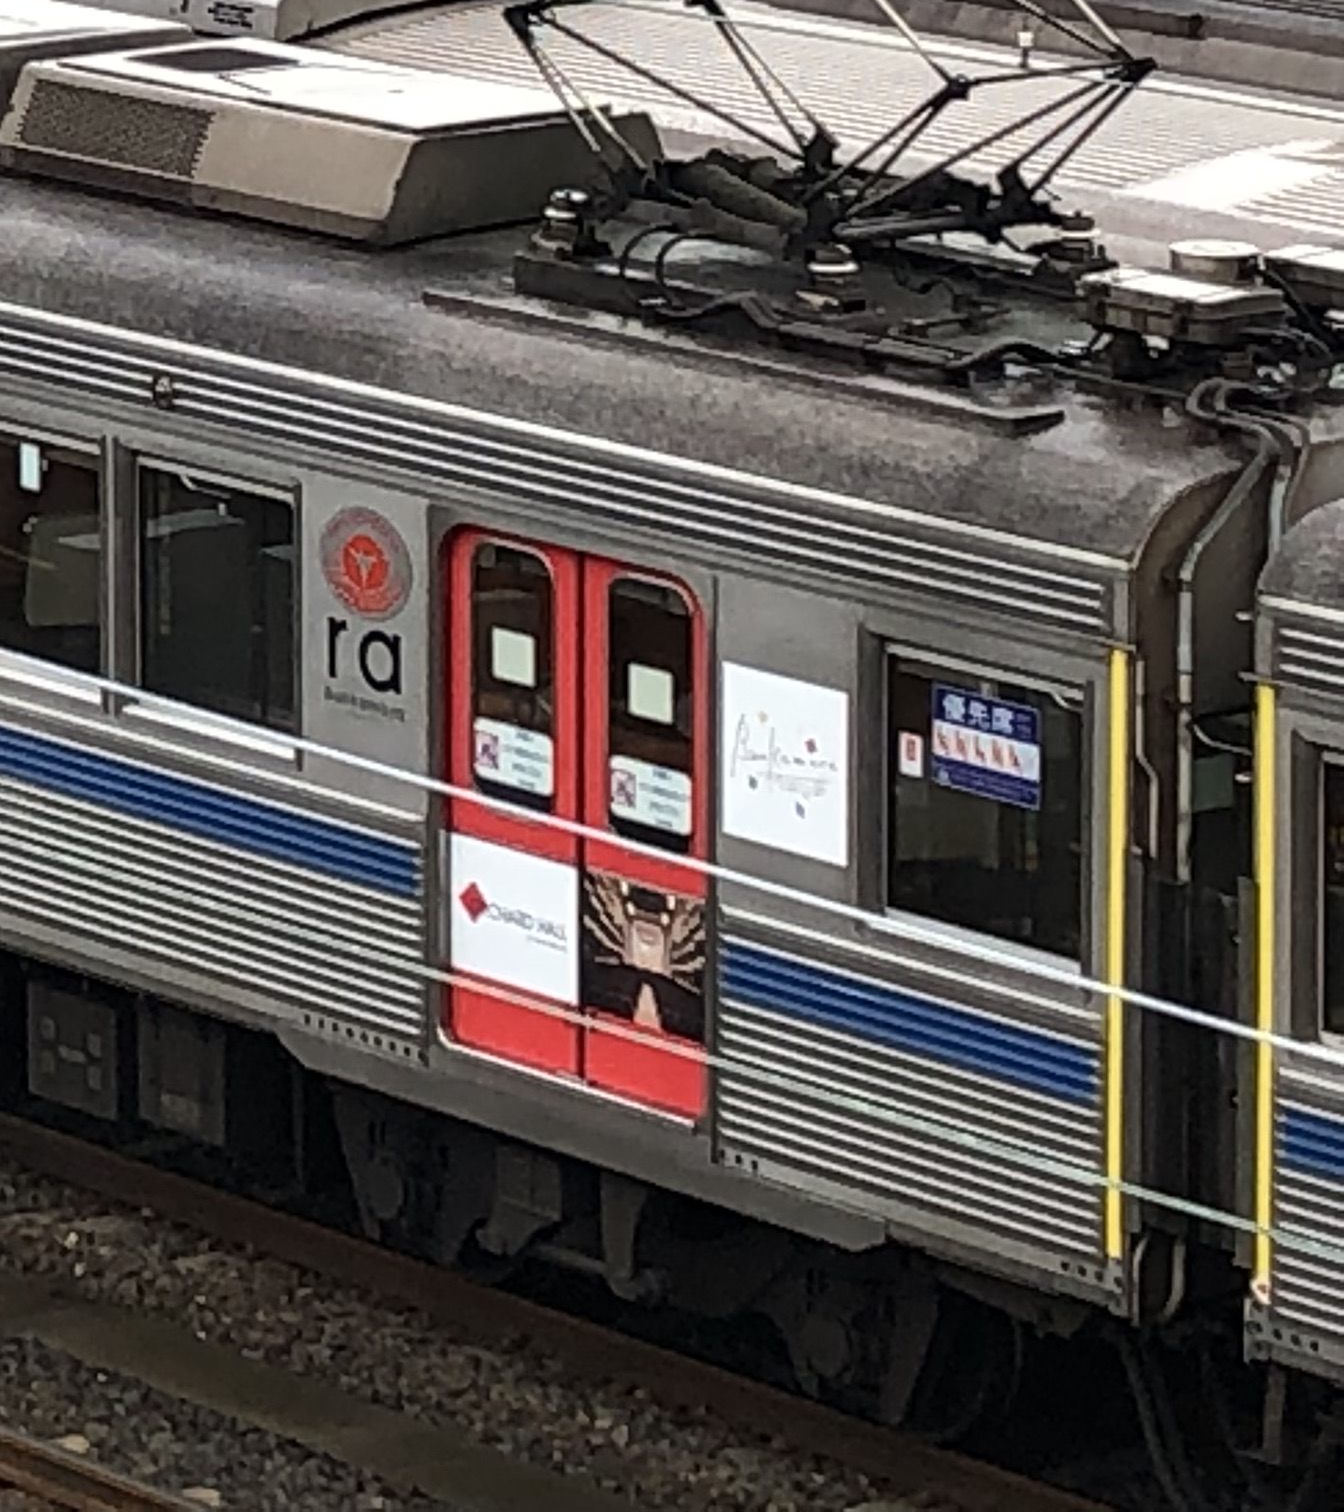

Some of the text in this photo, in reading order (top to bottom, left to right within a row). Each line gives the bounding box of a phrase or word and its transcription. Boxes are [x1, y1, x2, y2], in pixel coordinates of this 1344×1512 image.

[327, 616, 402, 695] ra
[942, 693, 1015, 735] 優先席
